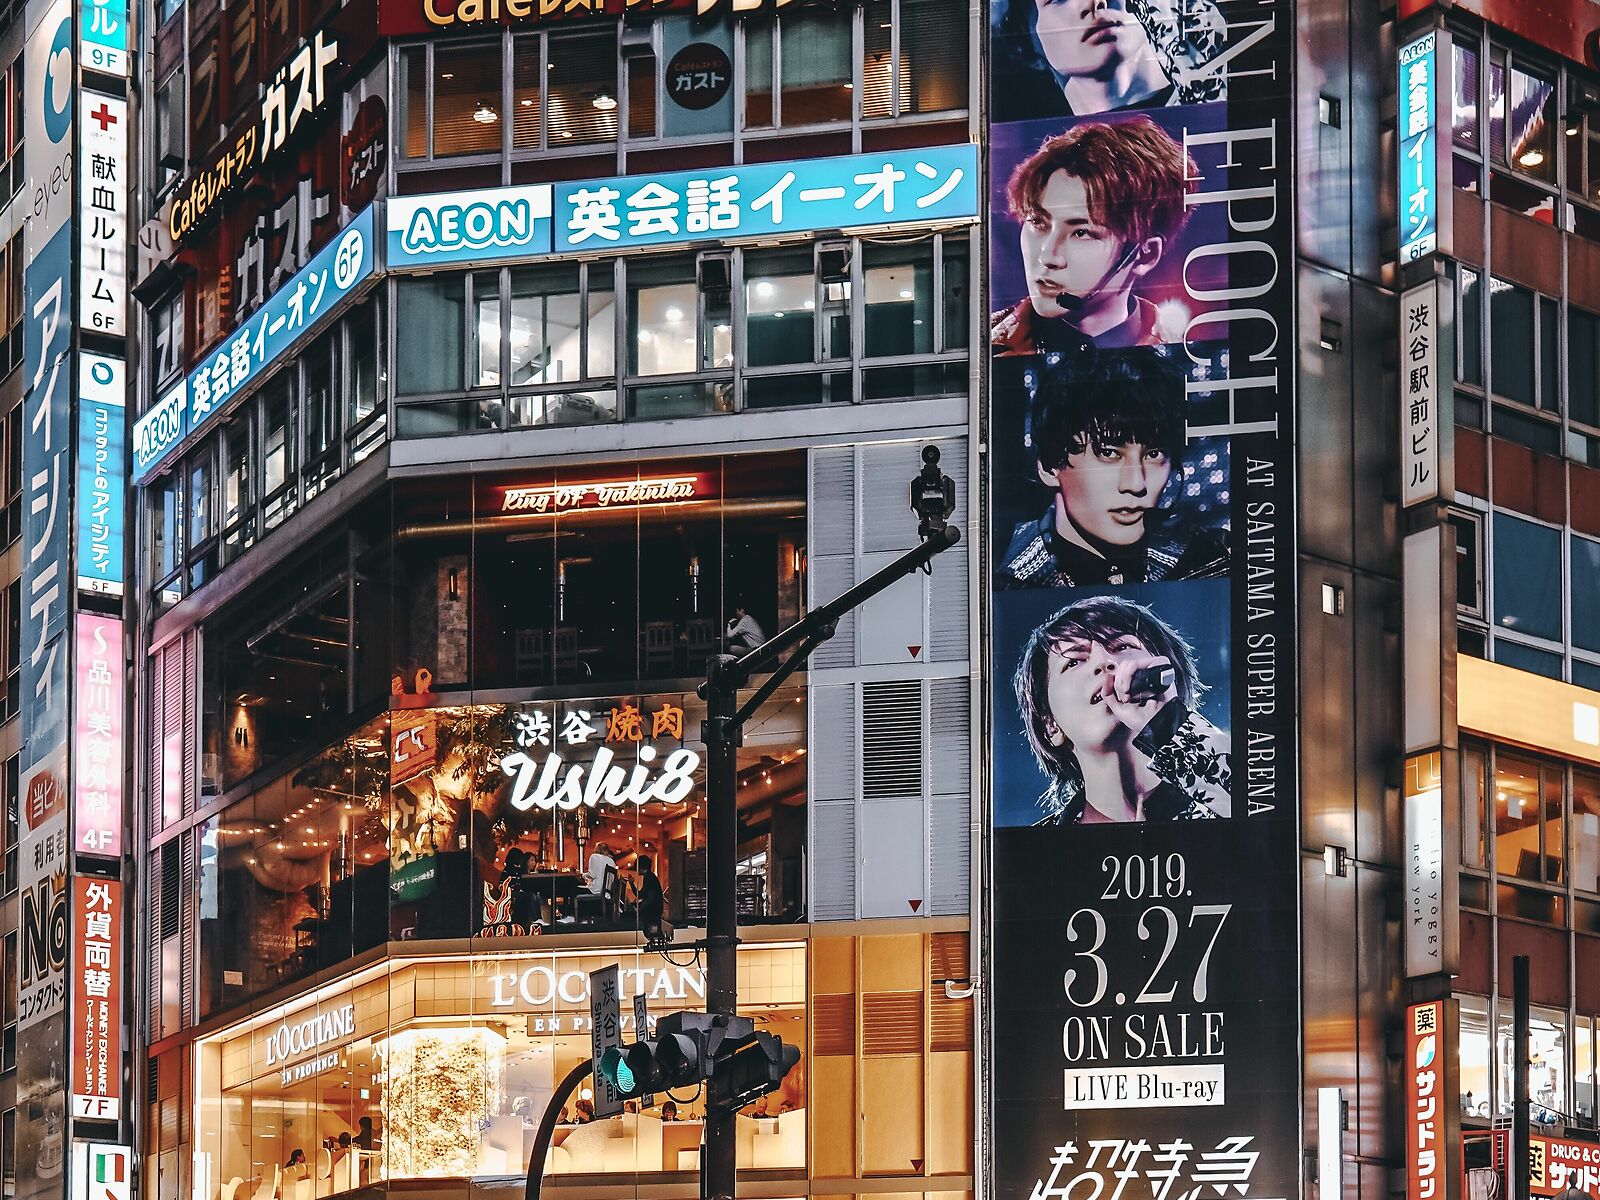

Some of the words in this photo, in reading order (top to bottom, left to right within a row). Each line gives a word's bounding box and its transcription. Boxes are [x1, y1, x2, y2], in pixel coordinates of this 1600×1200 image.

[90, 0, 118, 35] ル
[92, 49, 118, 68] 9F
[1401, 37, 1435, 66] AEON
[261, 29, 338, 163] ガスト
[675, 71, 725, 91] ガスト
[406, 200, 533, 249] AEON
[566, 162, 965, 246] 英会話イーオン
[90, 153, 116, 305] 献血ルーム
[1410, 240, 1428, 260] 6F
[1182, 118, 1279, 445] EPOCH
[92, 314, 115, 329] 6F
[192, 268, 329, 424] 英会話イーオン
[338, 235, 359, 282] 6F
[1408, 306, 1431, 490] 渋谷駅前ビル
[140, 397, 180, 465] AEON
[1246, 456, 1275, 487] AT
[1246, 502, 1276, 623] SAITAMA
[1246, 633, 1276, 719] SUPER
[517, 710, 597, 748] 渋谷
[605, 703, 685, 743] 焼肉
[500, 745, 700, 812] Ushi8
[1247, 728, 1276, 818] ARENA
[82, 829, 113, 851] 4F
[1100, 852, 1192, 900] 2019.
[83, 881, 113, 999] 外貨両替
[1063, 903, 1233, 1008] 3.27
[97, 1000, 109, 1038] MONEY
[265, 1003, 356, 1066] L'OCCITANE
[1061, 1015, 1113, 1062] ON
[1124, 1011, 1225, 1060] SALE
[1416, 1007, 1434, 1032] 薬
[97, 1040, 109, 1096] EXCHANGE
[295, 1052, 339, 1080] PROVENCE
[1072, 1074, 1129, 1102] LIVE
[1136, 1067, 1219, 1102] Blu-ray
[82, 1098, 110, 1116] 7F
[1551, 1143, 1581, 1161] DRUG
